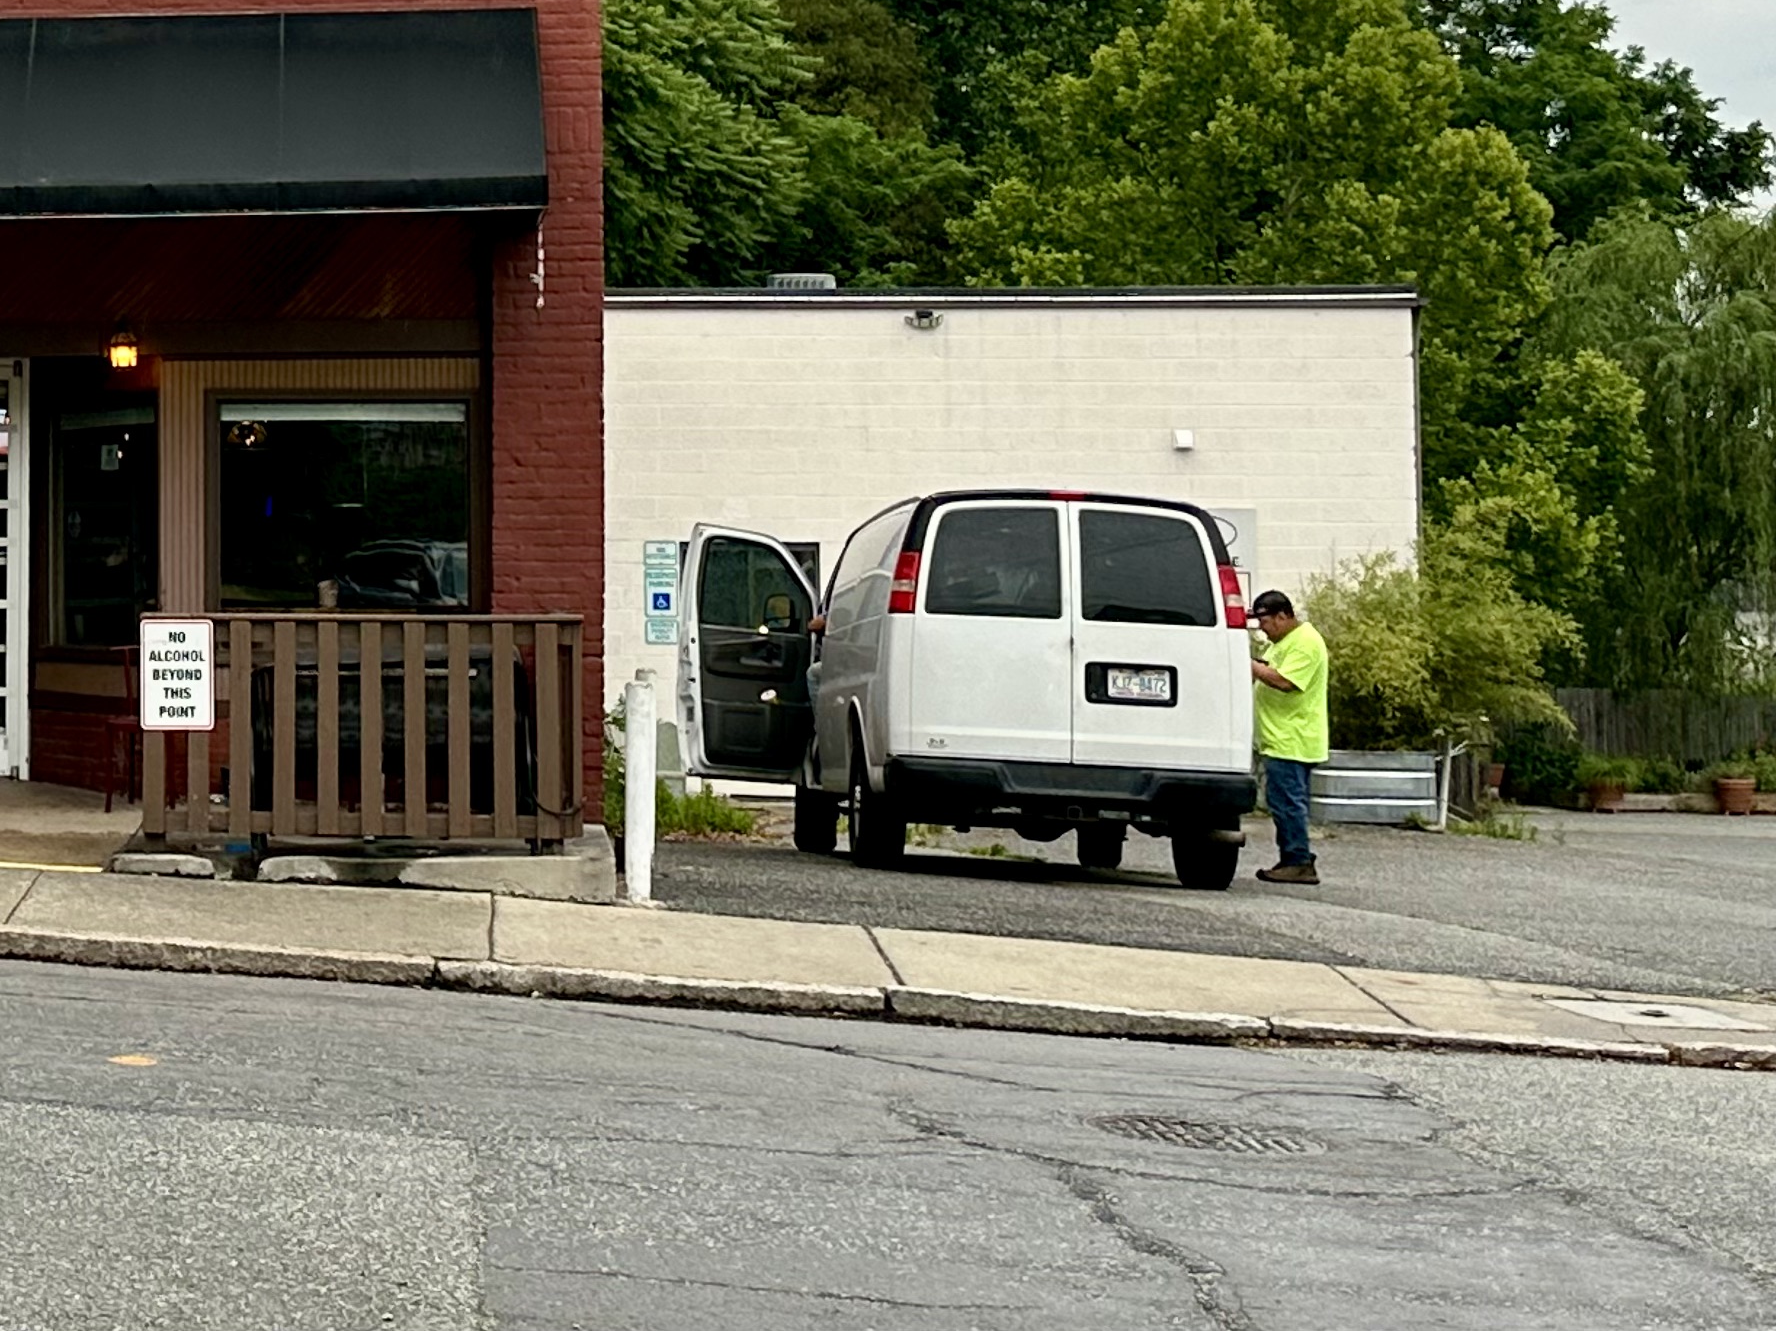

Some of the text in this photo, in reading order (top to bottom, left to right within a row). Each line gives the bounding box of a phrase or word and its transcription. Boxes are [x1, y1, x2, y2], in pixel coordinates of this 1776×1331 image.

[168, 631, 186, 644] NO
[148, 650, 206, 662] ALCOHOL
[152, 668, 202, 681] BEYOND
[163, 687, 192, 700] THIS
[158, 705, 196, 718] POINT
